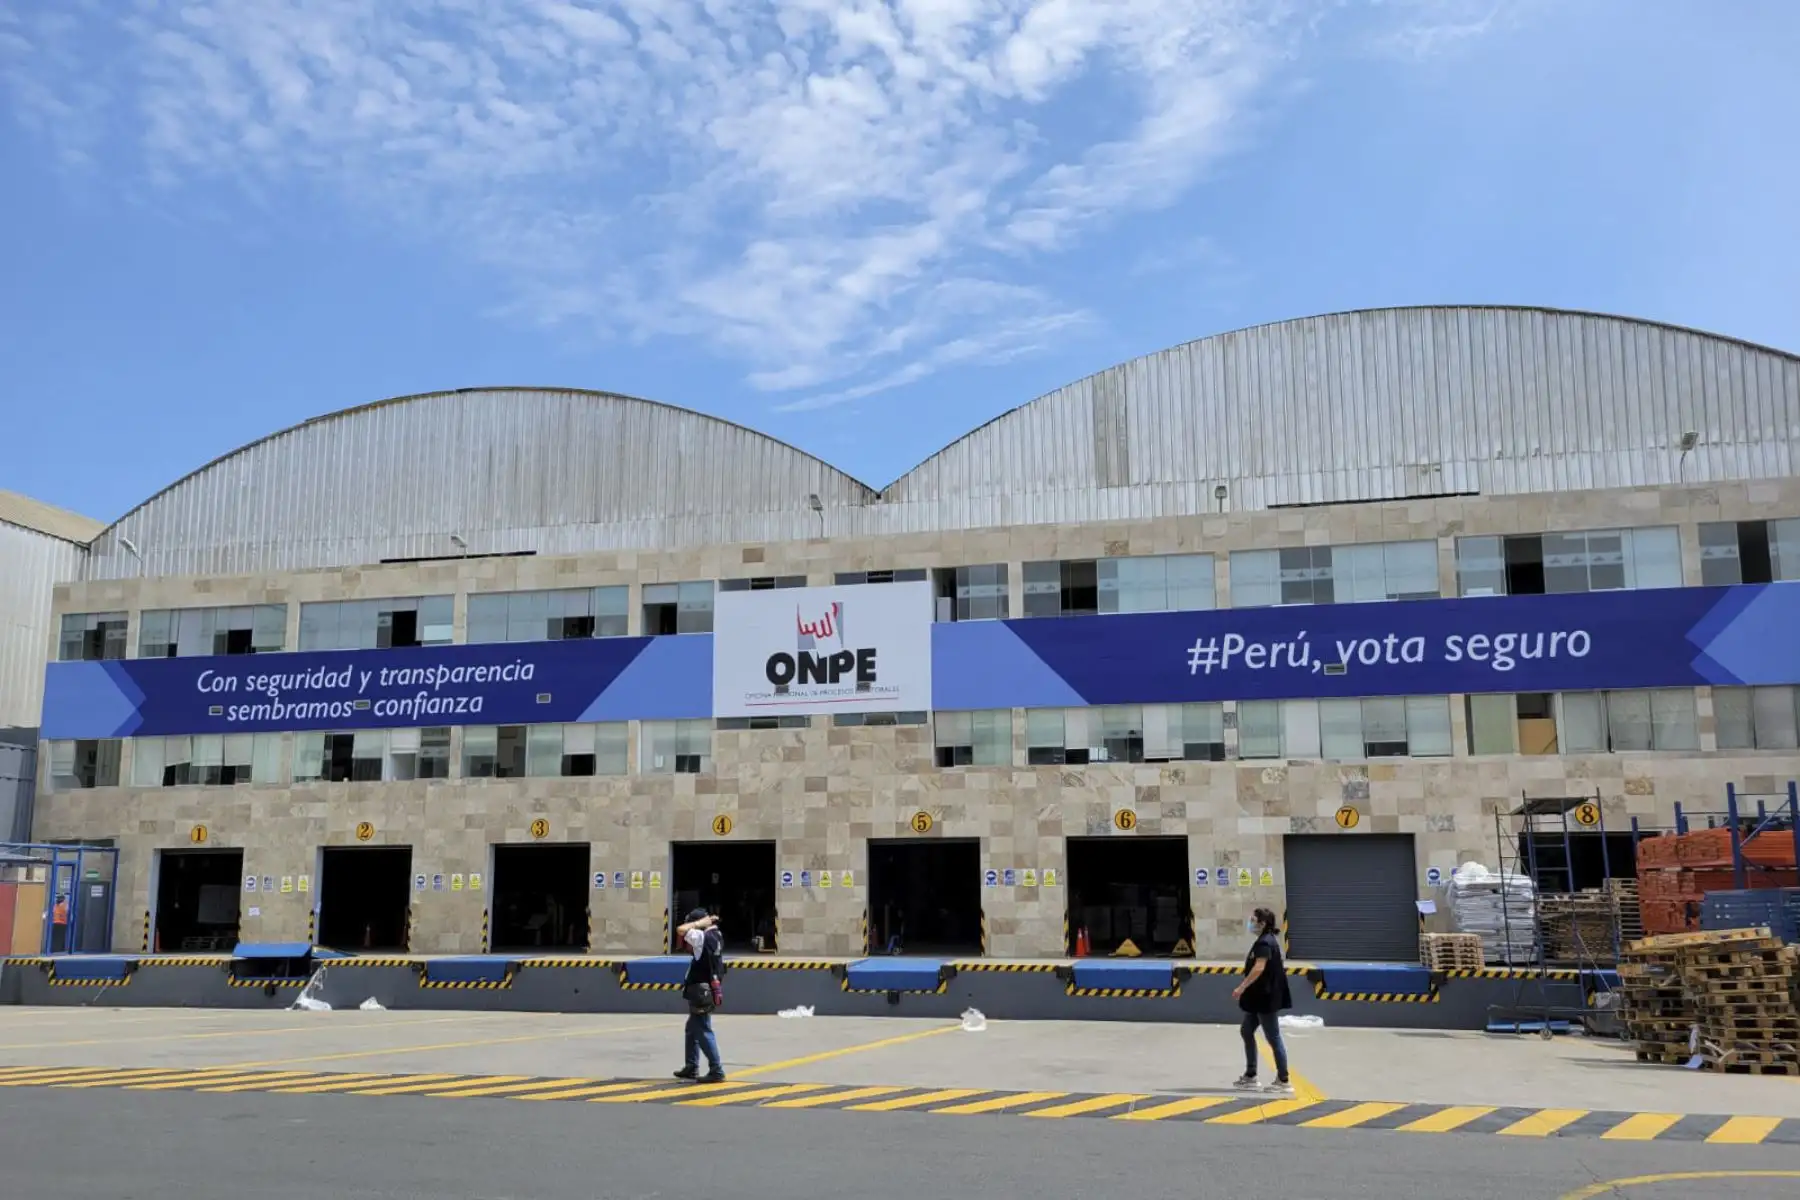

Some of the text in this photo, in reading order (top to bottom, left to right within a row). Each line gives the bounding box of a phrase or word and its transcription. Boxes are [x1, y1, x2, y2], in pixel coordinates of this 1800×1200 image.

[1187, 630, 1591, 675] #Perú, vota seguro
[765, 647, 878, 686] ONPE
[197, 658, 535, 697] Con seguridad y transparencia
[227, 690, 484, 721] sembramos confianza
[917, 814, 927, 831] 5
[1120, 811, 1131, 829] 6
[1341, 809, 1352, 826] 7
[1582, 804, 1594, 823] 8
[360, 823, 370, 838] 2
[535, 820, 545, 837] 3
[716, 817, 725, 833] 4
